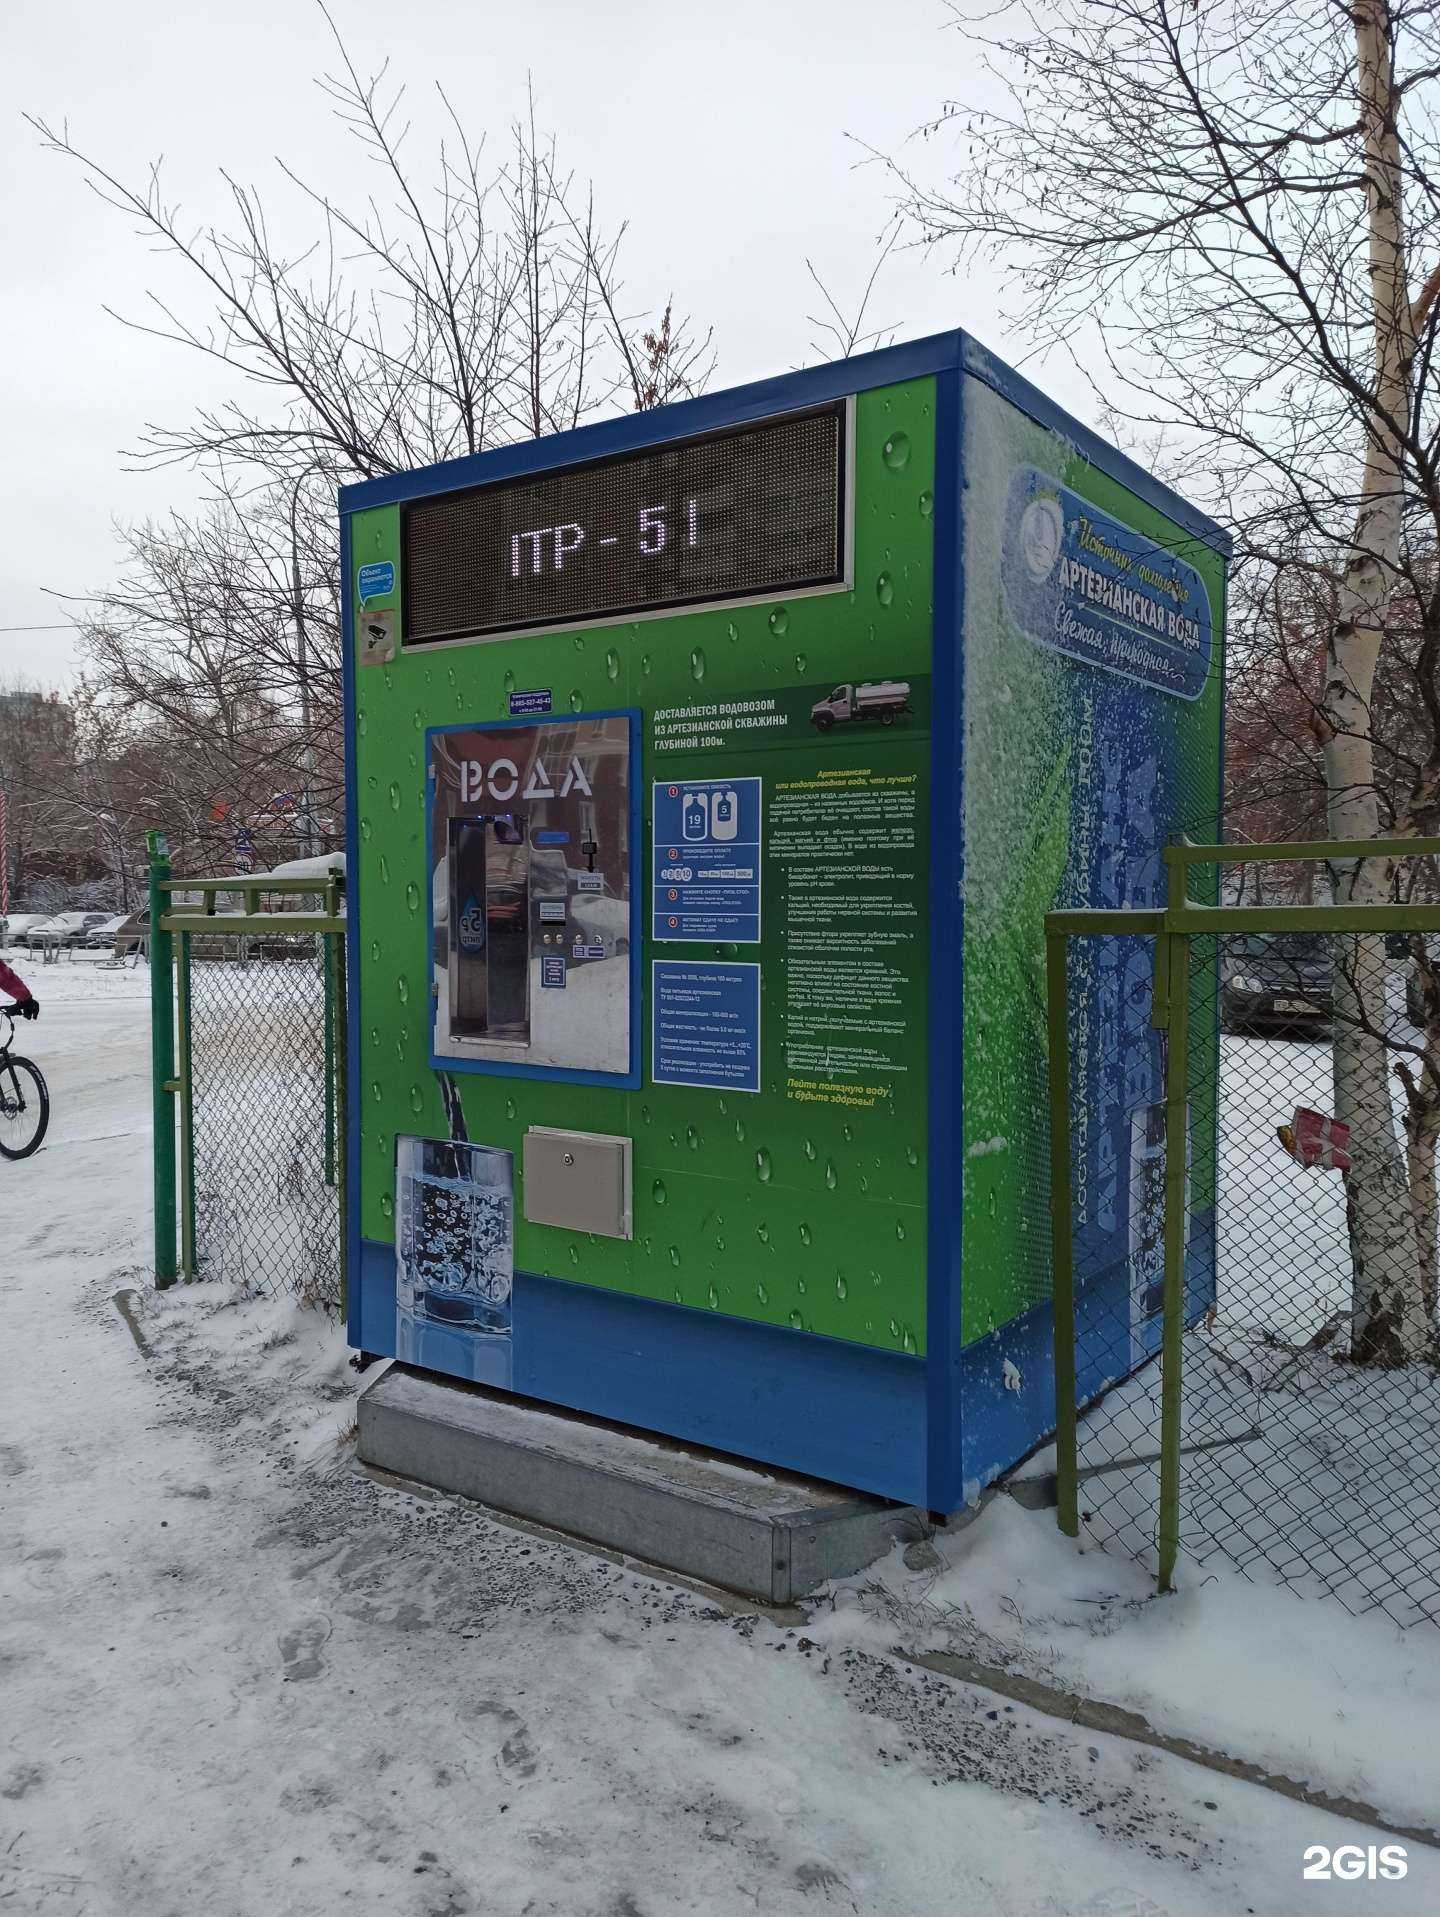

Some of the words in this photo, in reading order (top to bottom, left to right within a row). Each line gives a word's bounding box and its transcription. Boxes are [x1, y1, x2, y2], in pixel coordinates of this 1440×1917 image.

[1059, 557, 1165, 633] АРТЕЗИАНСКАЯ
[1138, 565, 1189, 604] долголеия
[654, 705, 717, 721] ДОСТАВЛЯЕТСЯ
[719, 699, 775, 714] ВОДОВОЗОМ
[655, 725, 665, 735] ИЗ
[667, 717, 733, 734] АРТЕЗИАНСКОЙ
[735, 715, 787, 728] СКВАЖИНЫ
[655, 736, 698, 750] ГЛУБИНОЙ
[461, 755, 593, 803] ВОДА
[688, 815, 701, 825] 19
[787, 1078, 817, 1089] Пейте
[866, 1086, 889, 1098] воду
